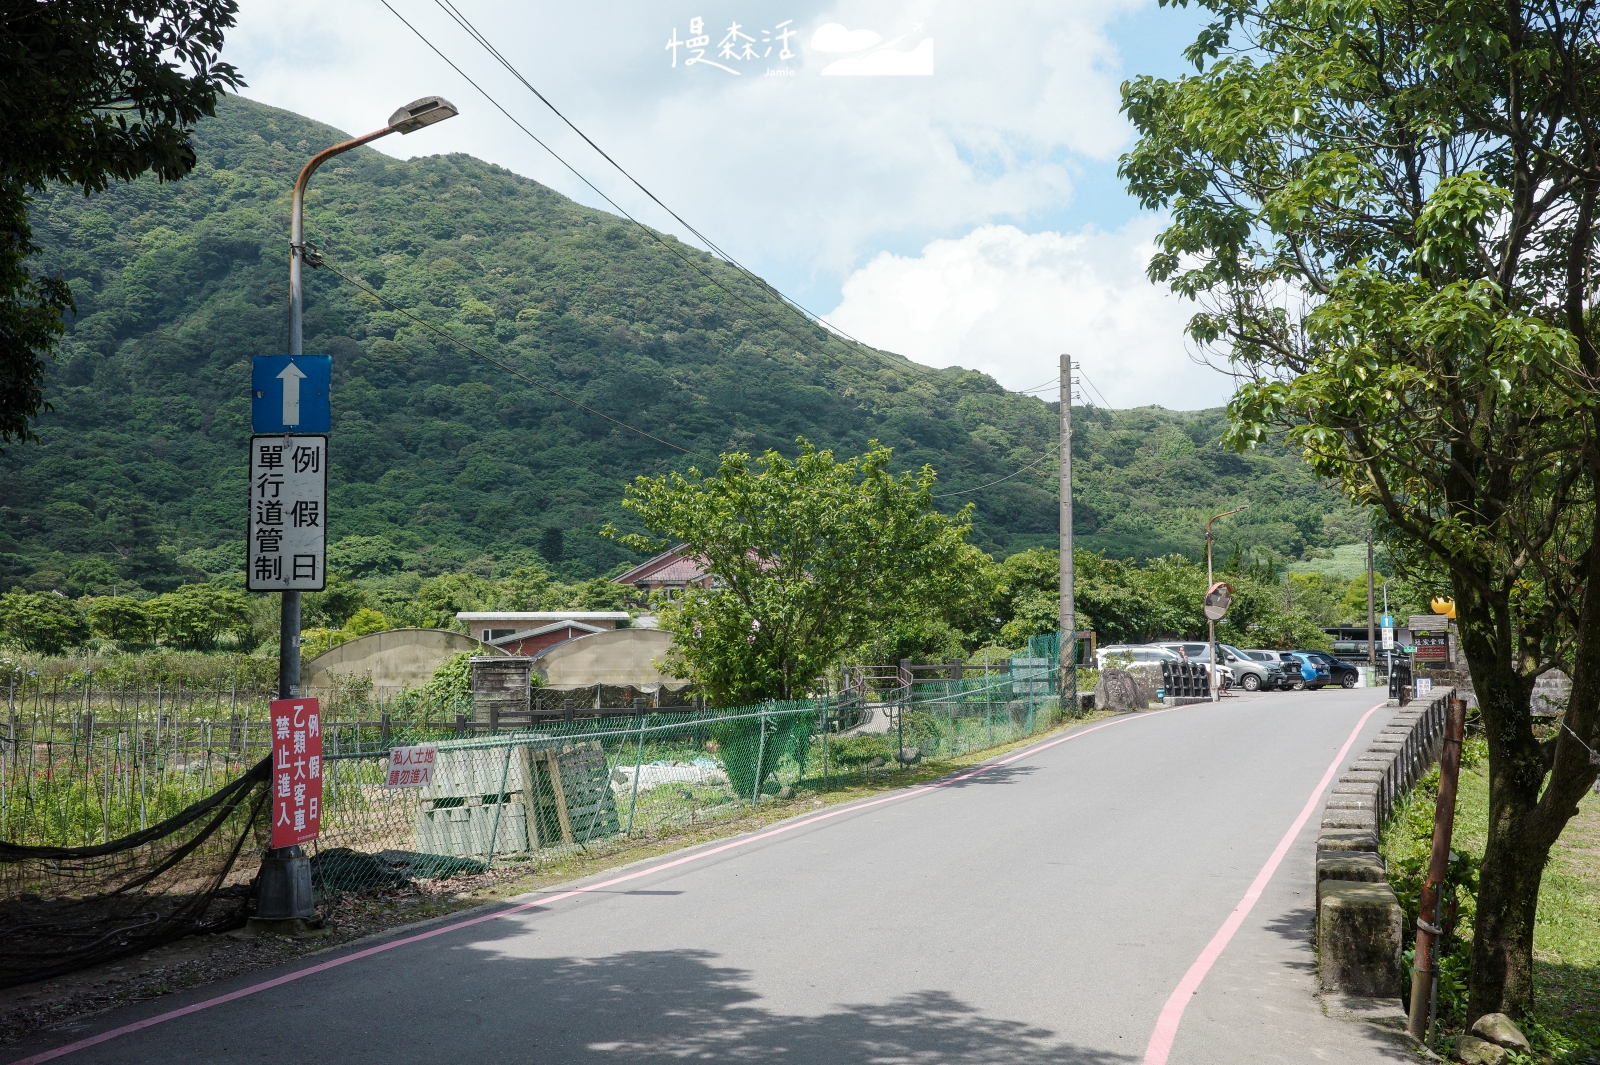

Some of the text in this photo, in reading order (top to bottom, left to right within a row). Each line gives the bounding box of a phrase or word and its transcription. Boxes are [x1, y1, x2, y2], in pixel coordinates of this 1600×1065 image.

[254, 445, 284, 582] 單行道管制
[291, 445, 320, 581] 例假日
[276, 716, 291, 827] 禁止進入
[293, 705, 306, 832] 乙類大客車
[308, 714, 320, 820] 例假日
[388, 768, 429, 786] 請勿進入
[392, 748, 434, 765] 私人土地
